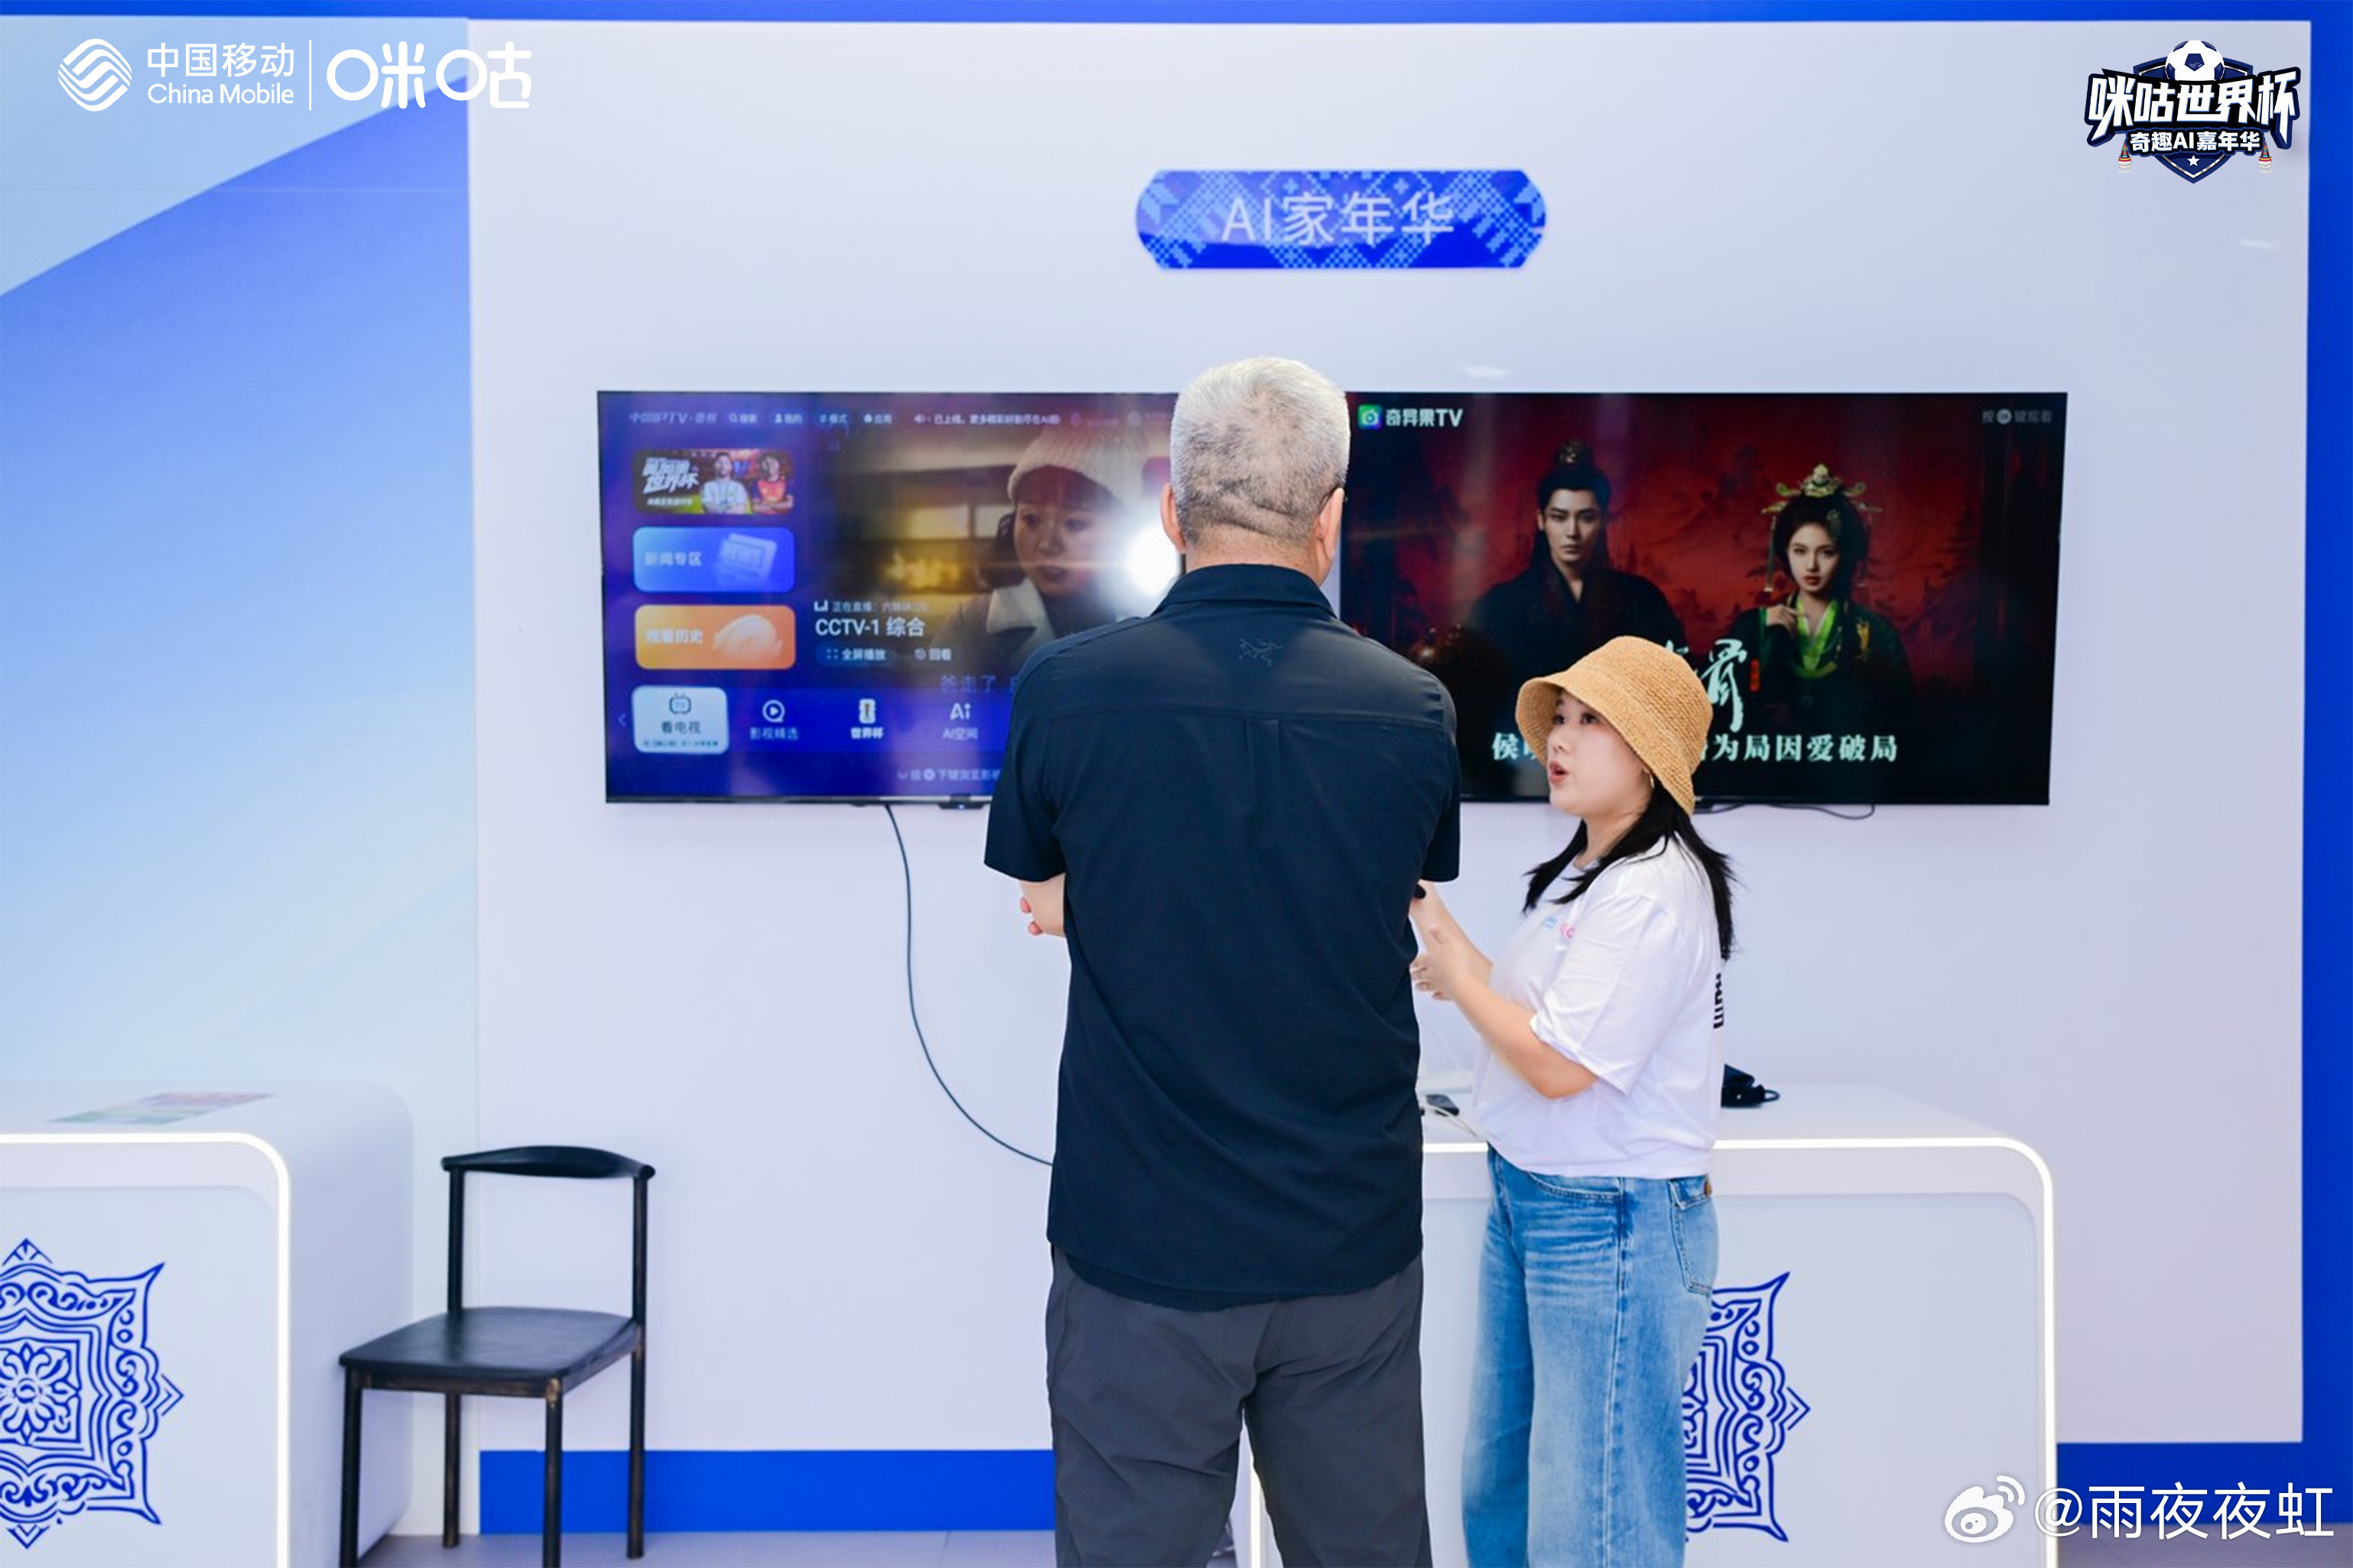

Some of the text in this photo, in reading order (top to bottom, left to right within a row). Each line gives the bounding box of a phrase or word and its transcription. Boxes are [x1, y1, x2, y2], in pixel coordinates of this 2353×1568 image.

[1222, 191, 1455, 247] AI家年华
[1386, 408, 1464, 427] 奇异果TV
[815, 617, 925, 637] CCTV-1 综合
[842, 648, 886, 661] 全屏播放
[928, 649, 951, 661] 回看
[661, 721, 701, 735] 看电视
[850, 727, 884, 739] 世界杯
[1700, 732, 1898, 762] 为局因爱破局
